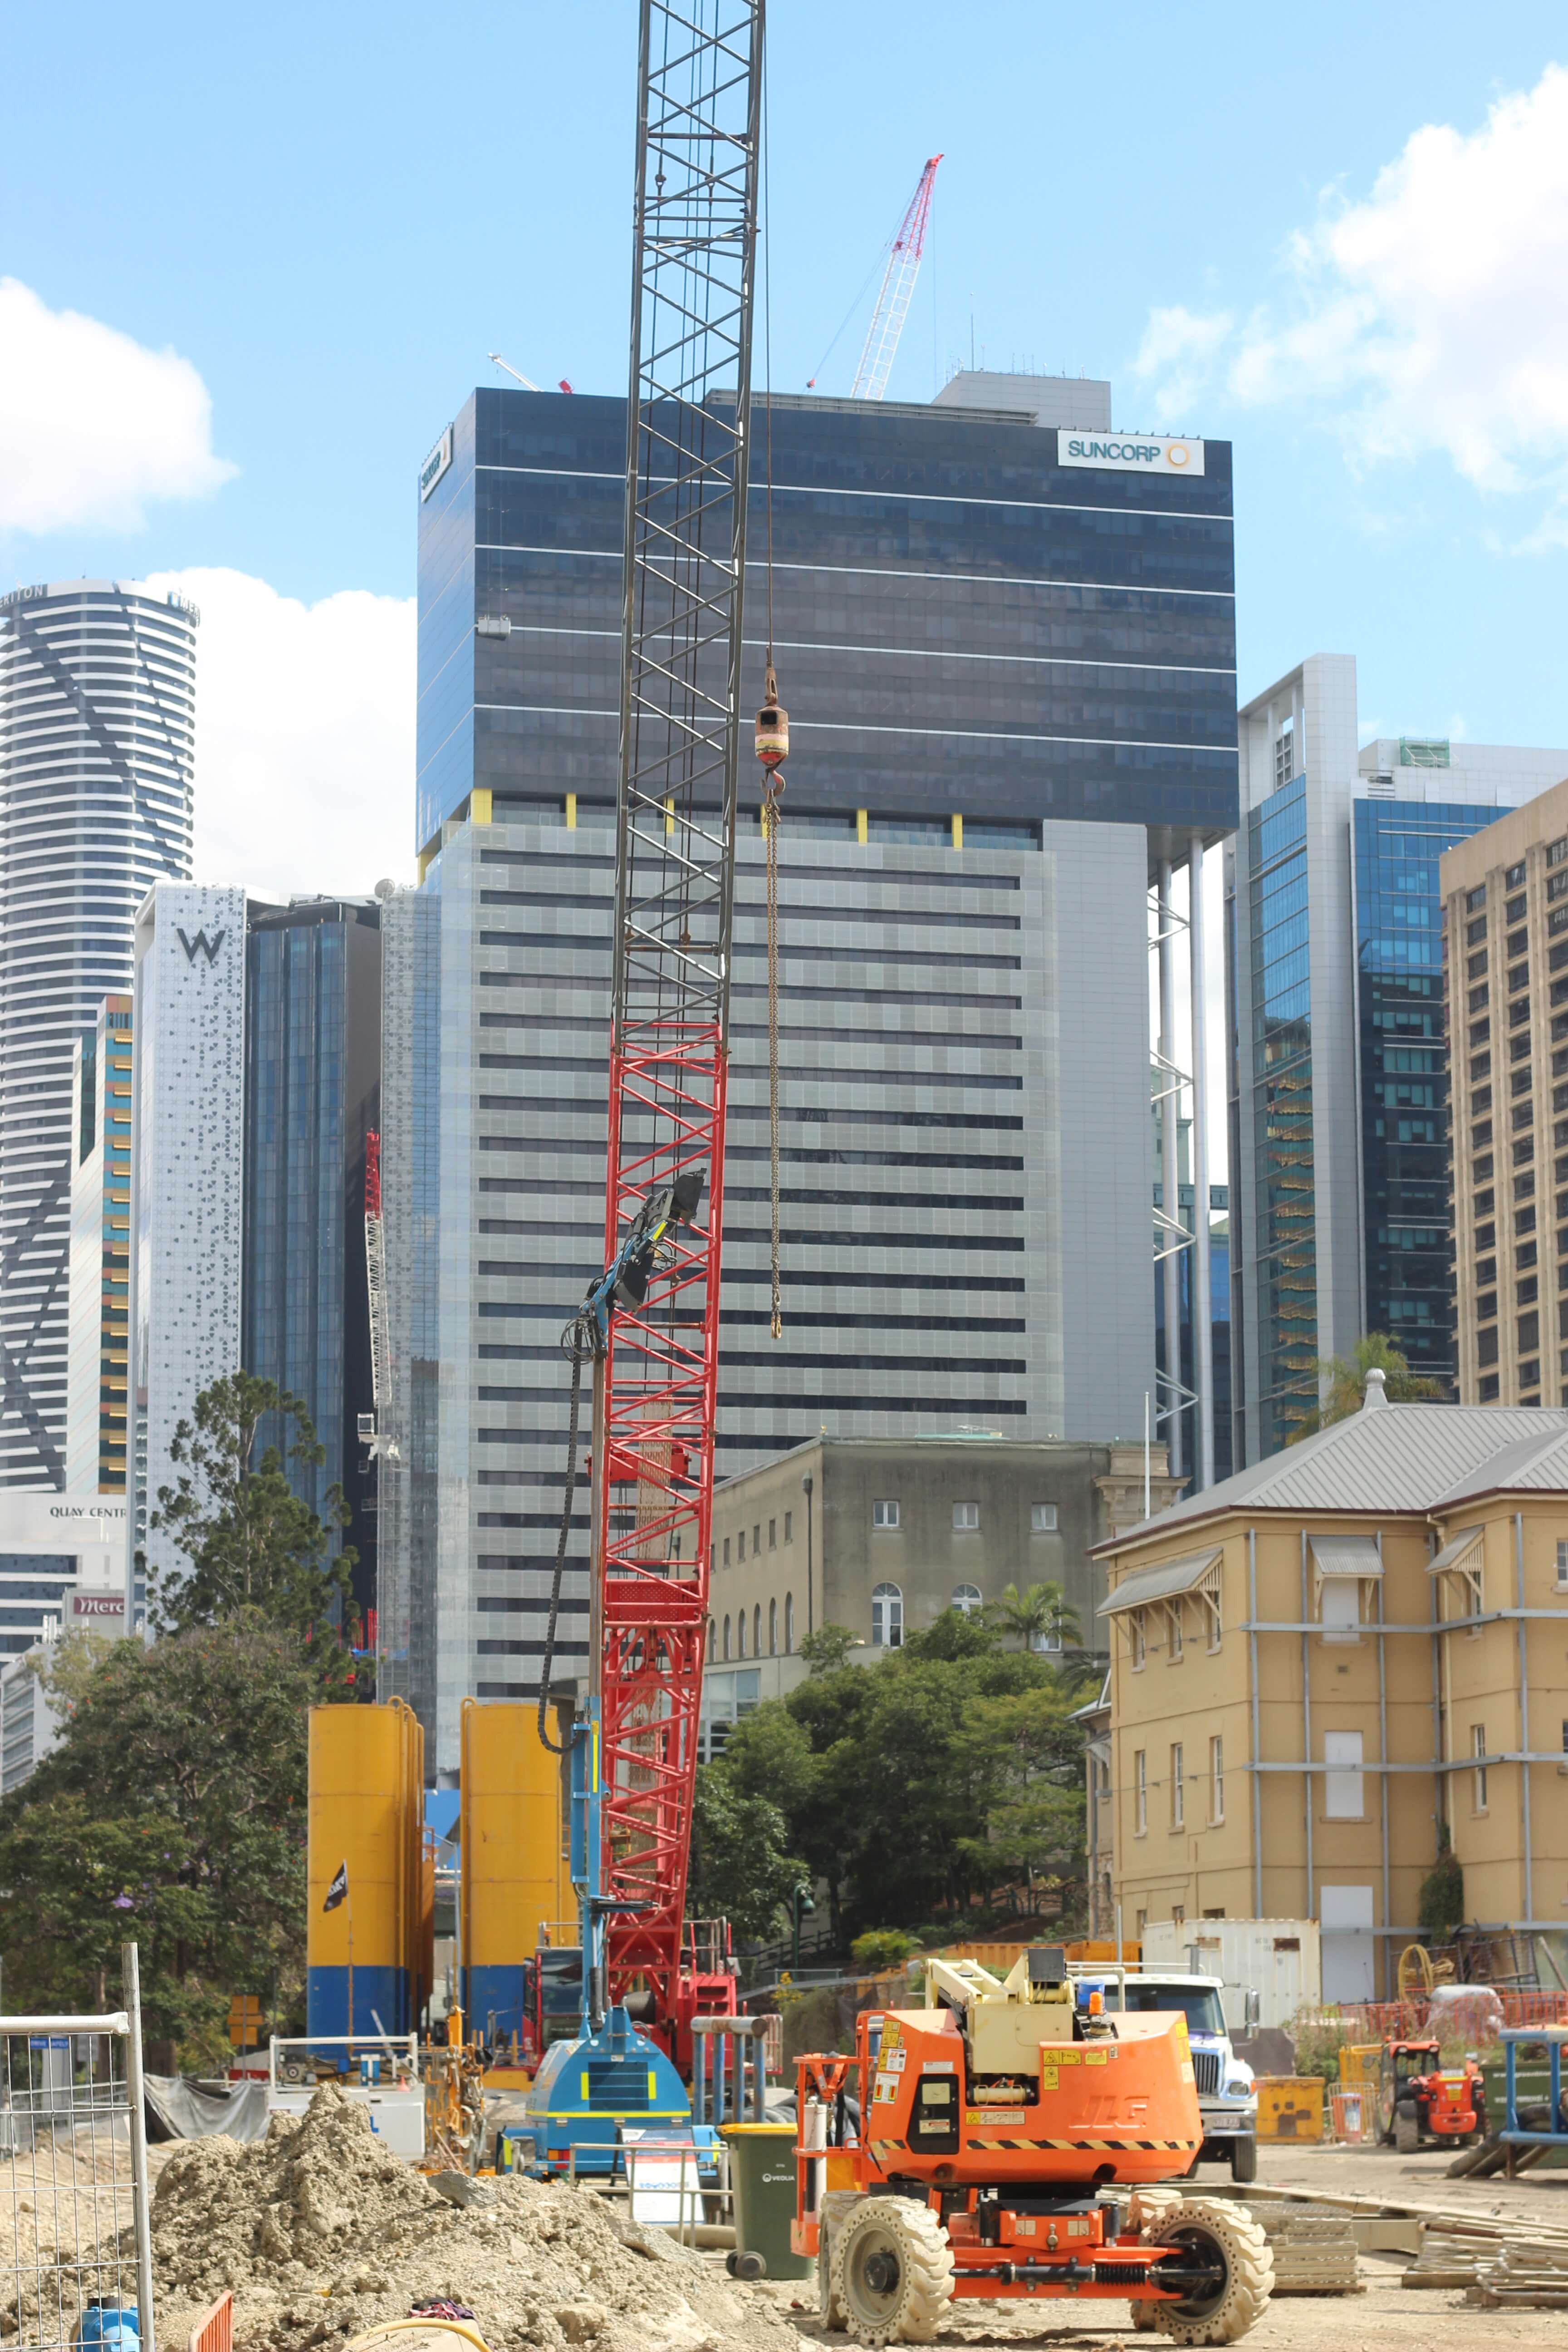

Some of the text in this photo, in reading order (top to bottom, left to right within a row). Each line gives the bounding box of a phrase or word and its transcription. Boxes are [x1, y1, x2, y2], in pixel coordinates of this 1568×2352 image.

[1068, 440, 1161, 462] SUNCORP
[176, 928, 226, 964] W
[50, 1507, 84, 1518] QUAY
